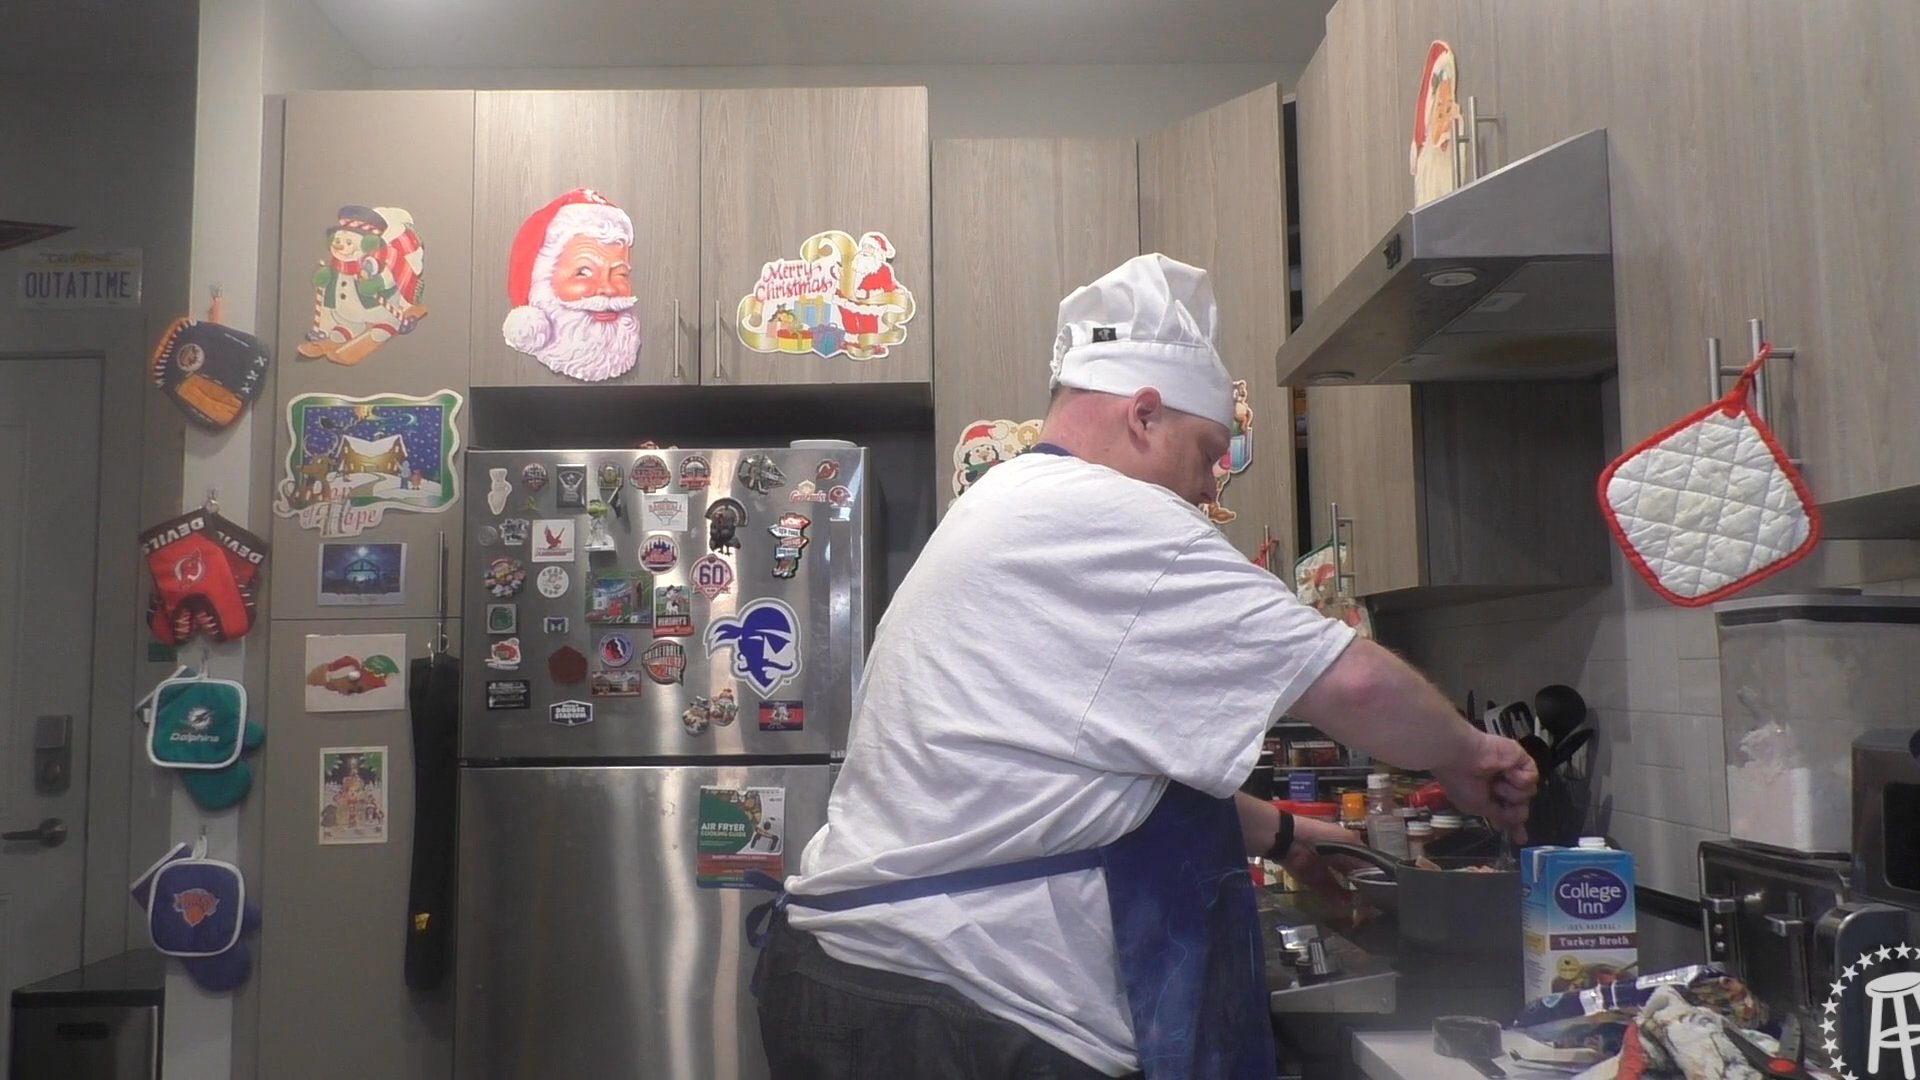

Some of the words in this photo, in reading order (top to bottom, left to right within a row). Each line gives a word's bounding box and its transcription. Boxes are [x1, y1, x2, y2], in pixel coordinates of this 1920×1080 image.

[763, 262, 822, 283] Merry
[24, 271, 132, 299] OUTATIME
[756, 275, 833, 302] Christmas
[217, 530, 264, 565] DEVIL
[699, 564, 724, 586] 60
[170, 732, 219, 743] Dolphins
[701, 822, 717, 831] AIR
[718, 823, 745, 832] FRYER
[1559, 882, 1622, 903] College
[1577, 899, 1605, 914] Inn
[1559, 936, 1597, 948] Turkey
[1599, 935, 1630, 945] Broth
